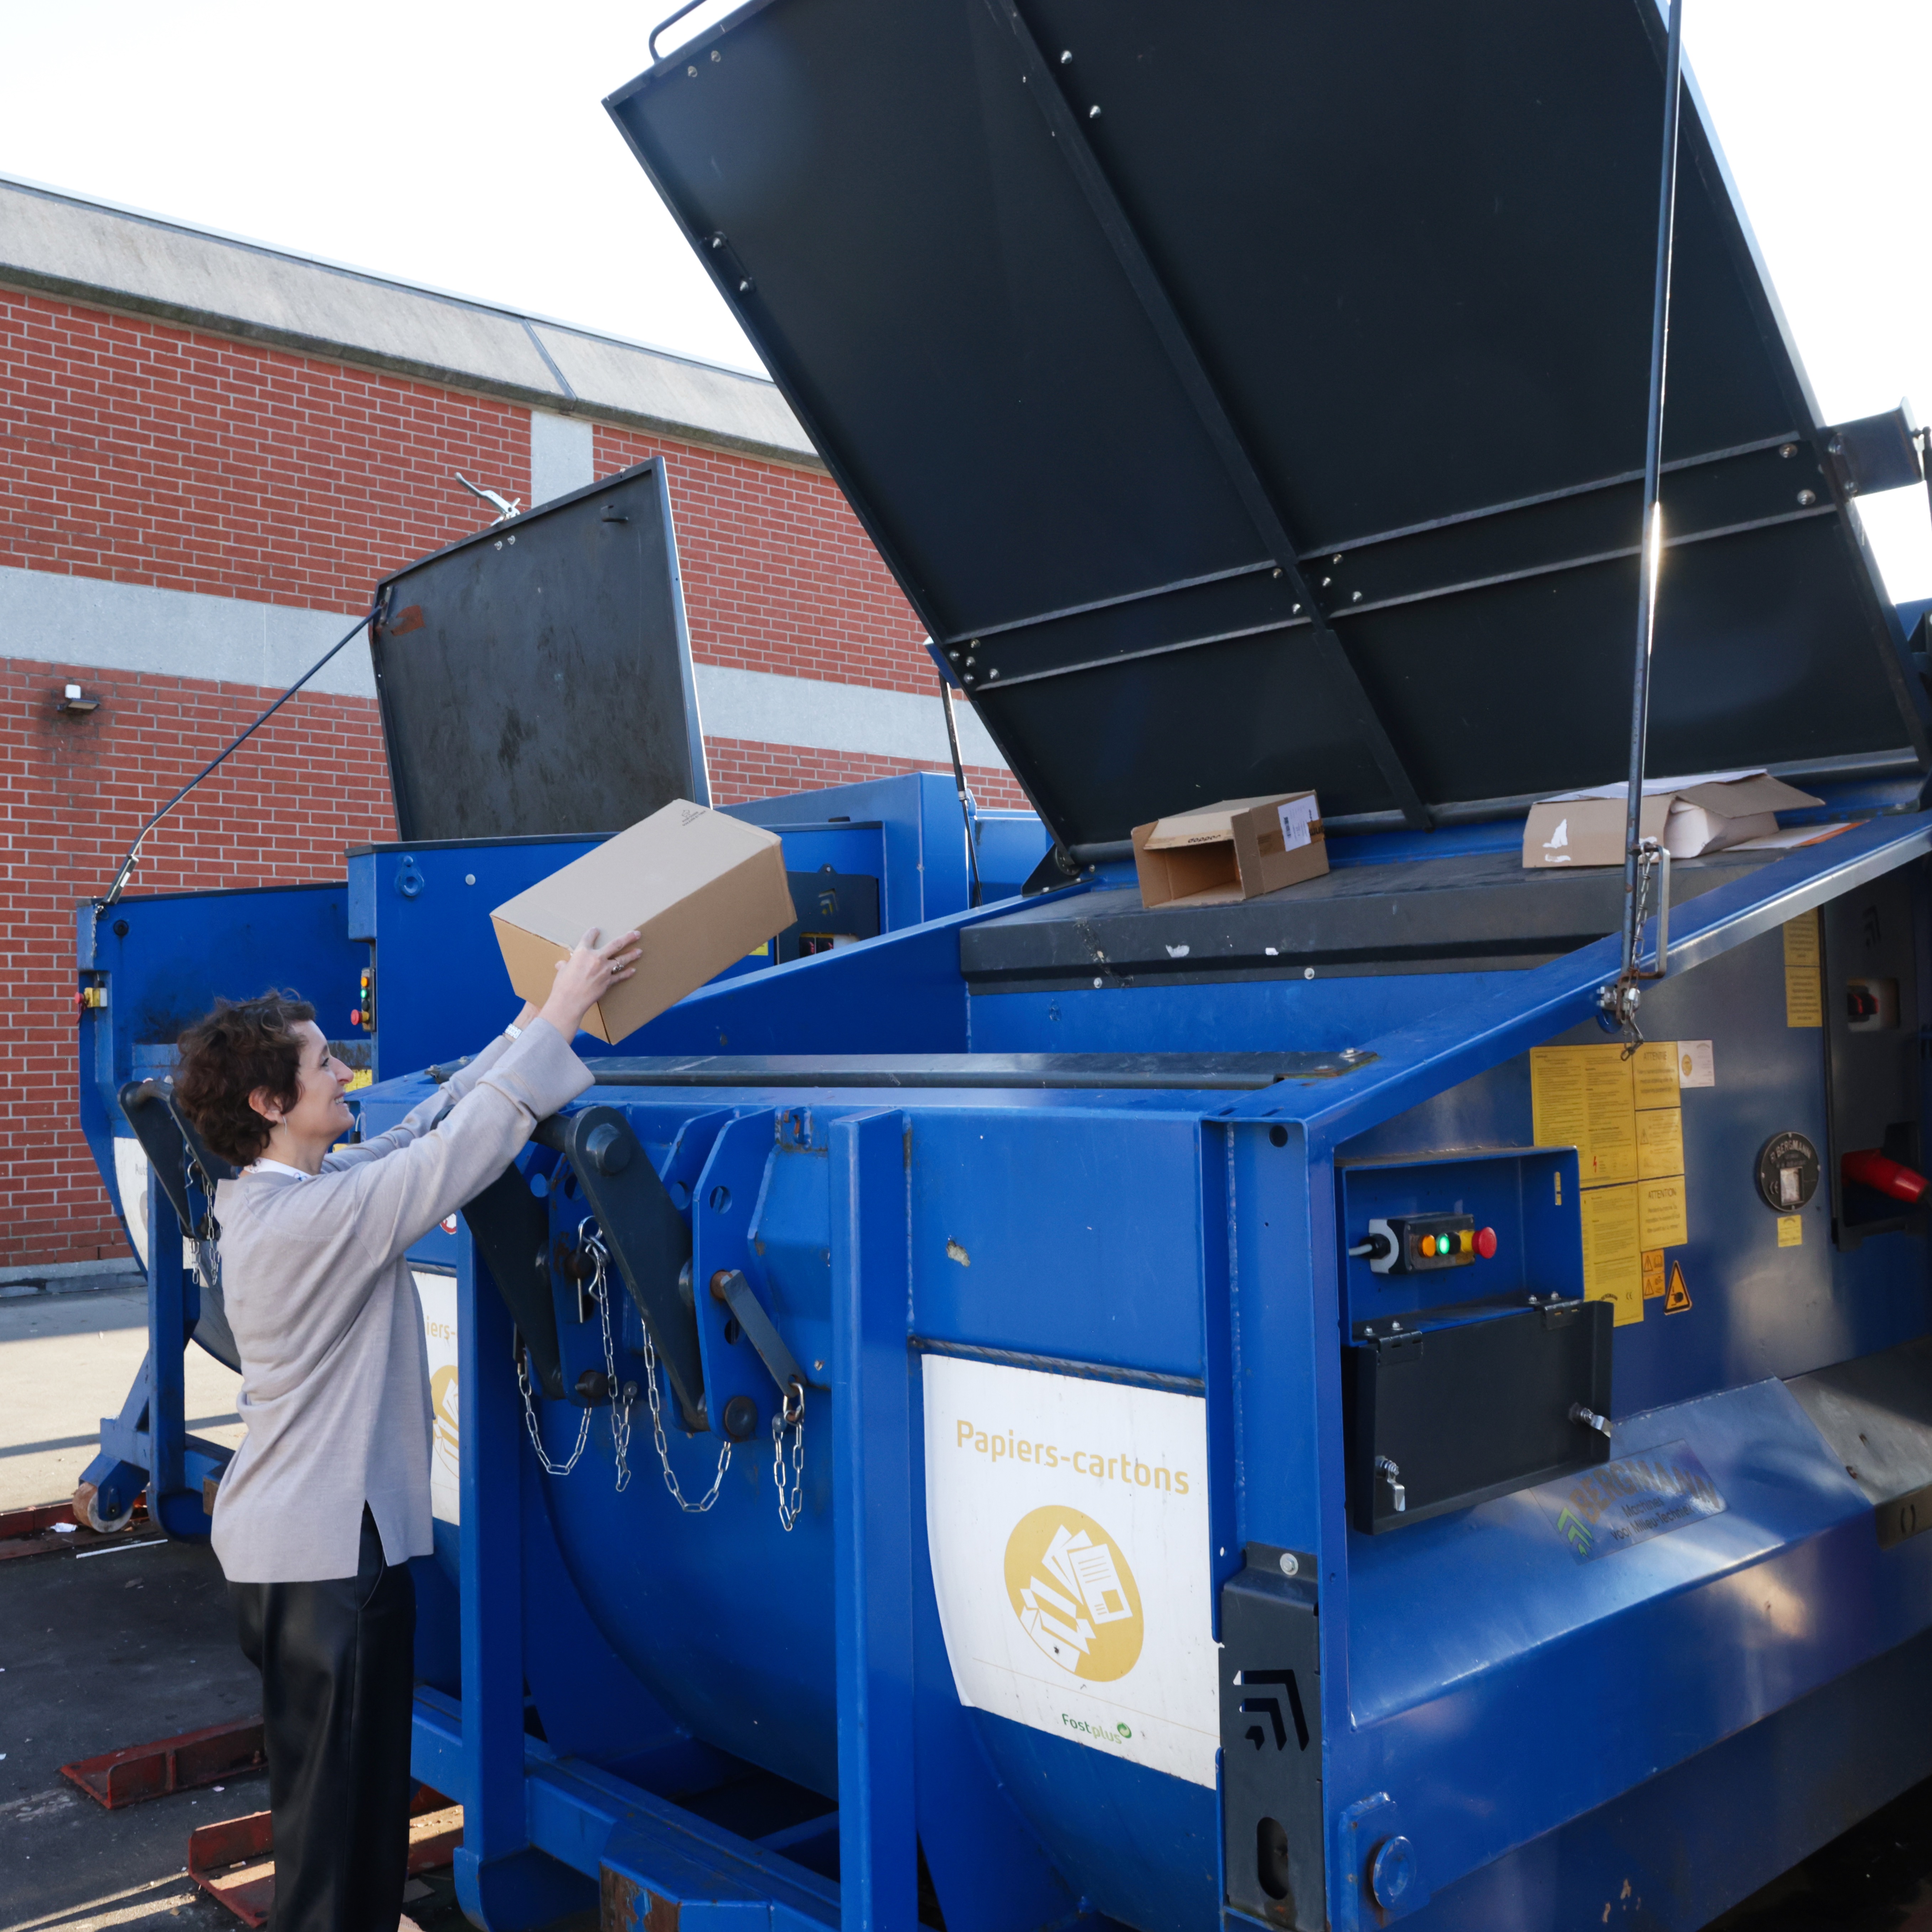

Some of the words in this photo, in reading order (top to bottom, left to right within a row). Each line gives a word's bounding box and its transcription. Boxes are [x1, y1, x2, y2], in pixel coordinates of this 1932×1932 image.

[1648, 1188, 1677, 1199] ATTENTION
[957, 1419, 1189, 1495] Papiers-cartons
[1569, 1460, 1721, 1525] BERGMANN
[1621, 1497, 1664, 1518] Machines
[1610, 1529, 1632, 1541] voor
[1629, 1504, 1695, 1535] Milieu-Techniek
